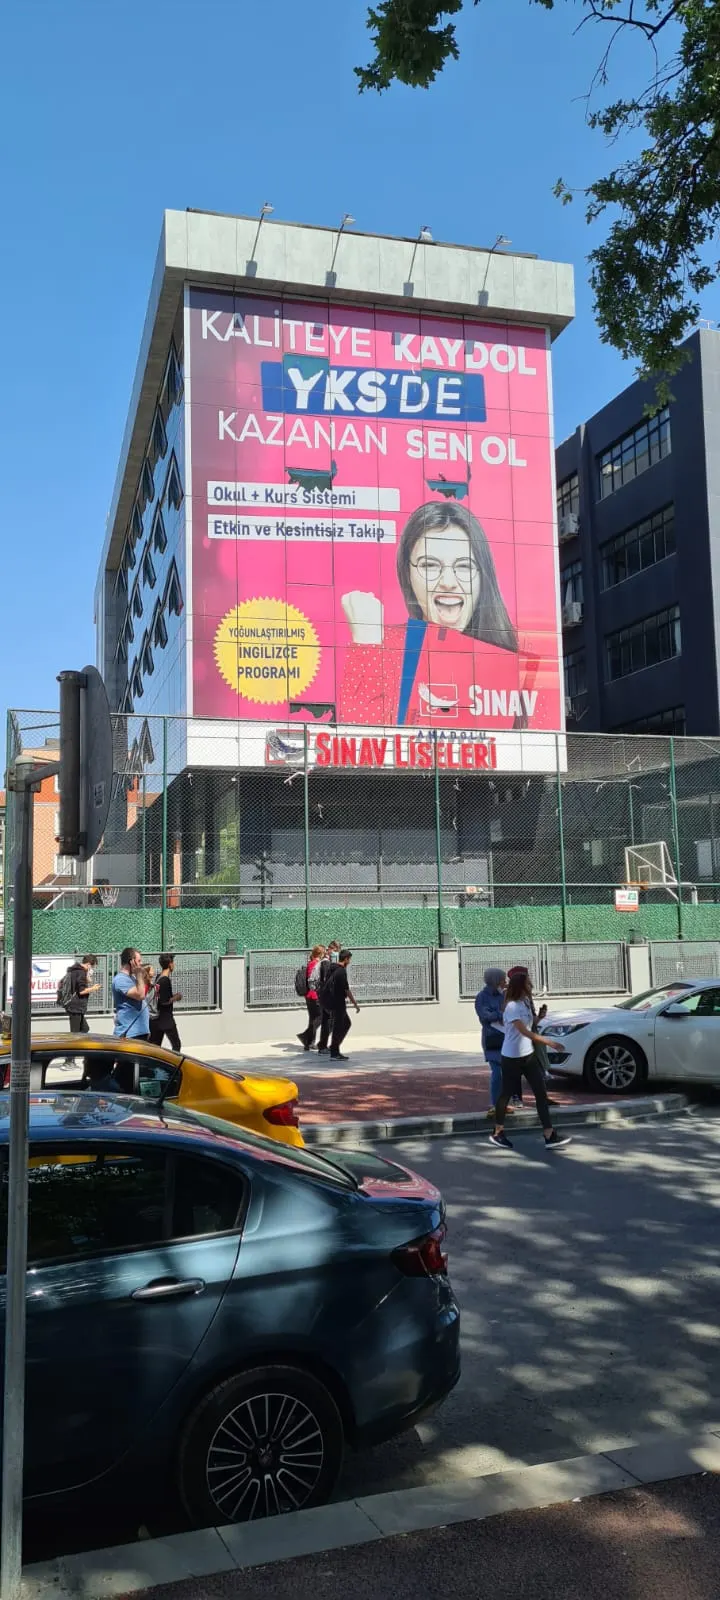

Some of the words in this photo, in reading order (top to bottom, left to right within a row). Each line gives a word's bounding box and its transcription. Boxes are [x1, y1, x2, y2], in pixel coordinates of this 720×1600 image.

[202, 309, 371, 358] KALİTEYE
[394, 331, 537, 376] KAYDOL
[287, 367, 462, 415] YKS'DE
[218, 410, 387, 456] KAZANAN
[406, 429, 473, 463] SEN
[480, 435, 528, 467] OL
[213, 486, 247, 502] Okul
[264, 487, 298, 504] Kurs
[302, 489, 356, 505] Sistemi
[213, 520, 250, 536] Etkin
[255, 524, 271, 536] ve
[276, 522, 344, 538] Kesintisiz
[348, 523, 385, 542] Takip
[228, 625, 306, 641] YOĞUNLAŞTIRILMIŞ
[237, 666, 300, 679] PROGRAMI
[468, 684, 538, 717] SINAV
[417, 730, 487, 740] ANADOLU
[316, 732, 388, 767] SINAV
[394, 734, 497, 770] LİSELERİ
